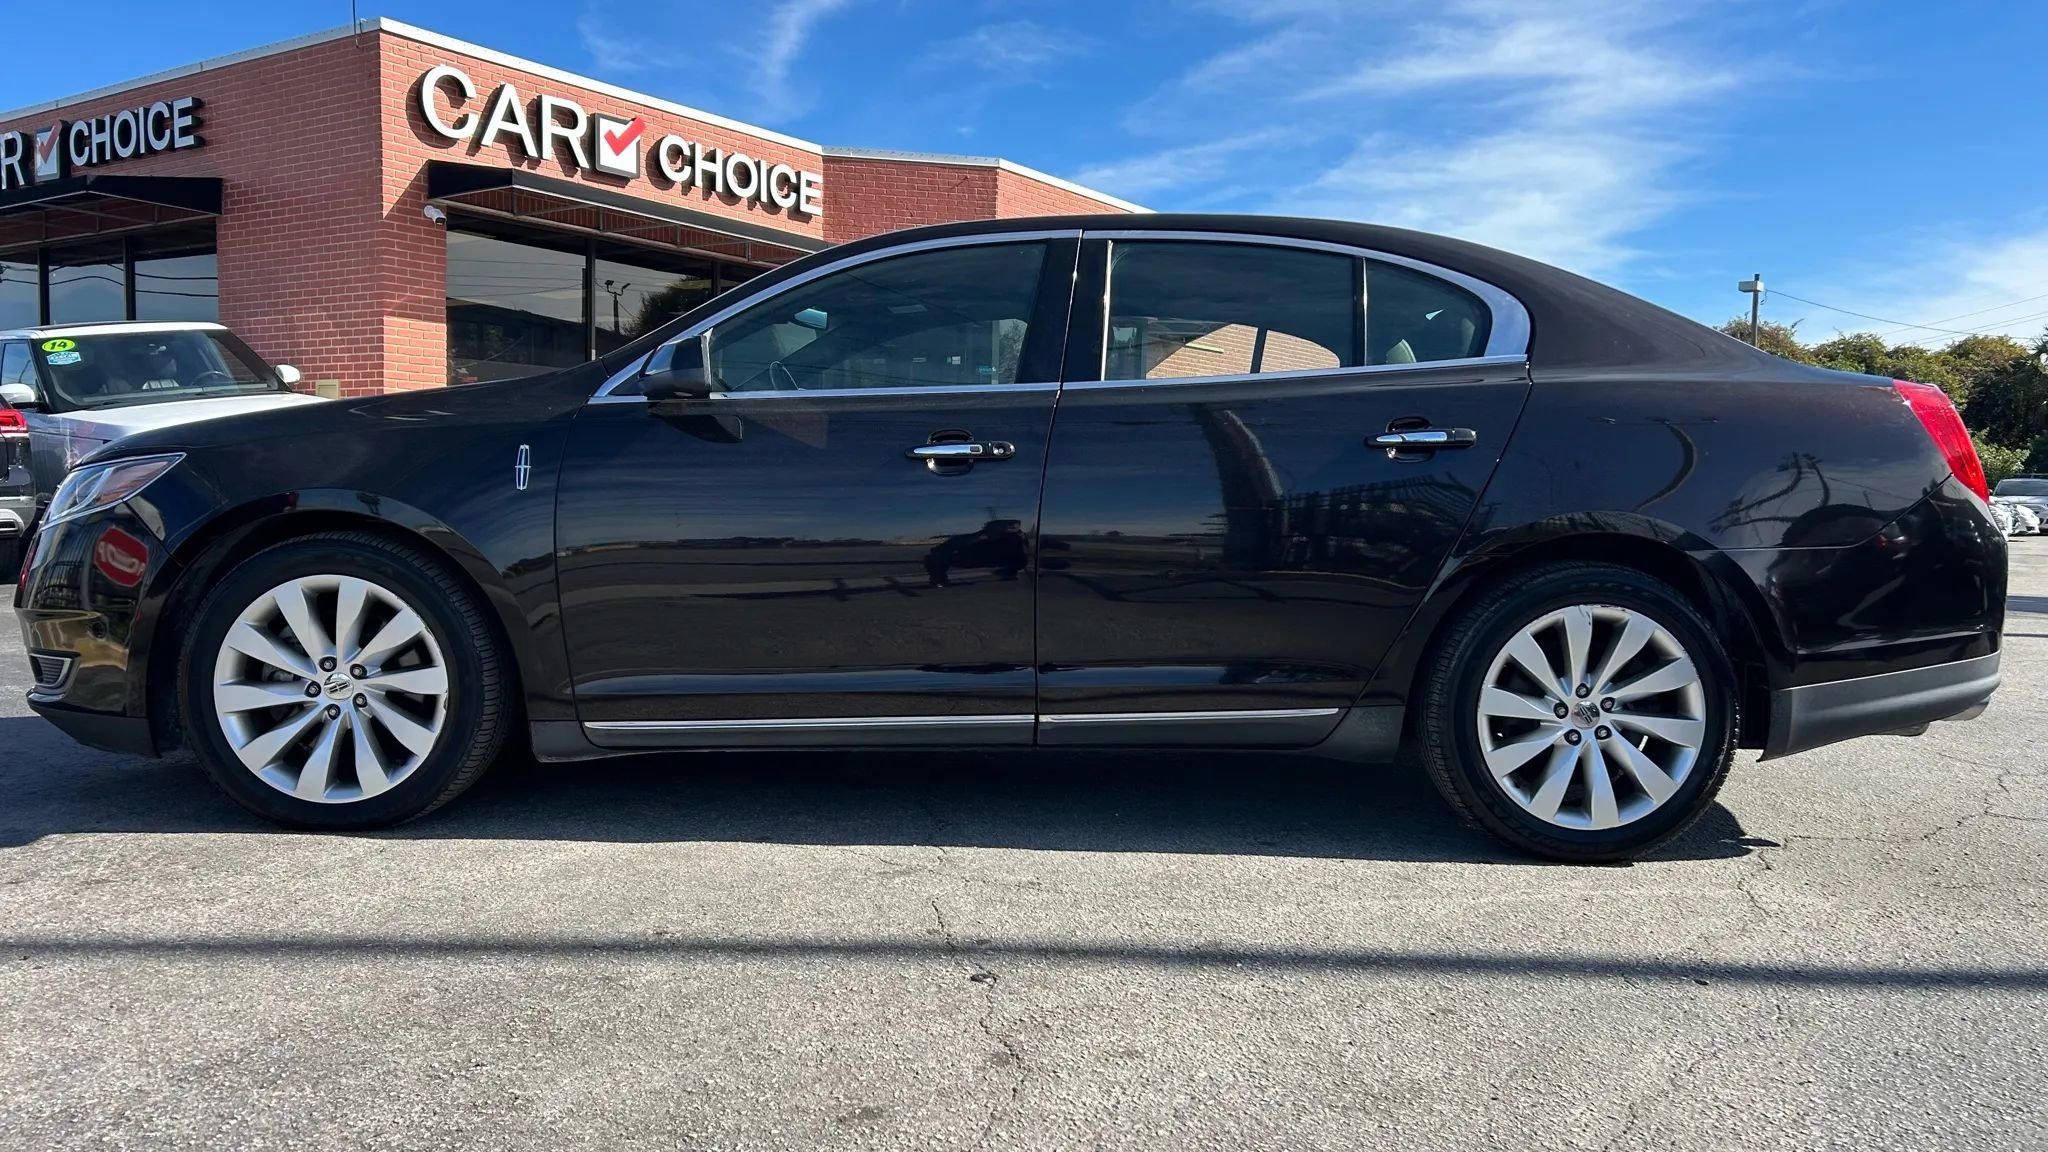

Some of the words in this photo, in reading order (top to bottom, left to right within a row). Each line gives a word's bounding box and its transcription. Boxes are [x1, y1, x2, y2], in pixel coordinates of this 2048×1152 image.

[69, 96, 196, 167] CHOICE
[420, 64, 590, 169] CAR
[658, 134, 824, 217] CHOICE
[50, 341, 68, 350] 14
